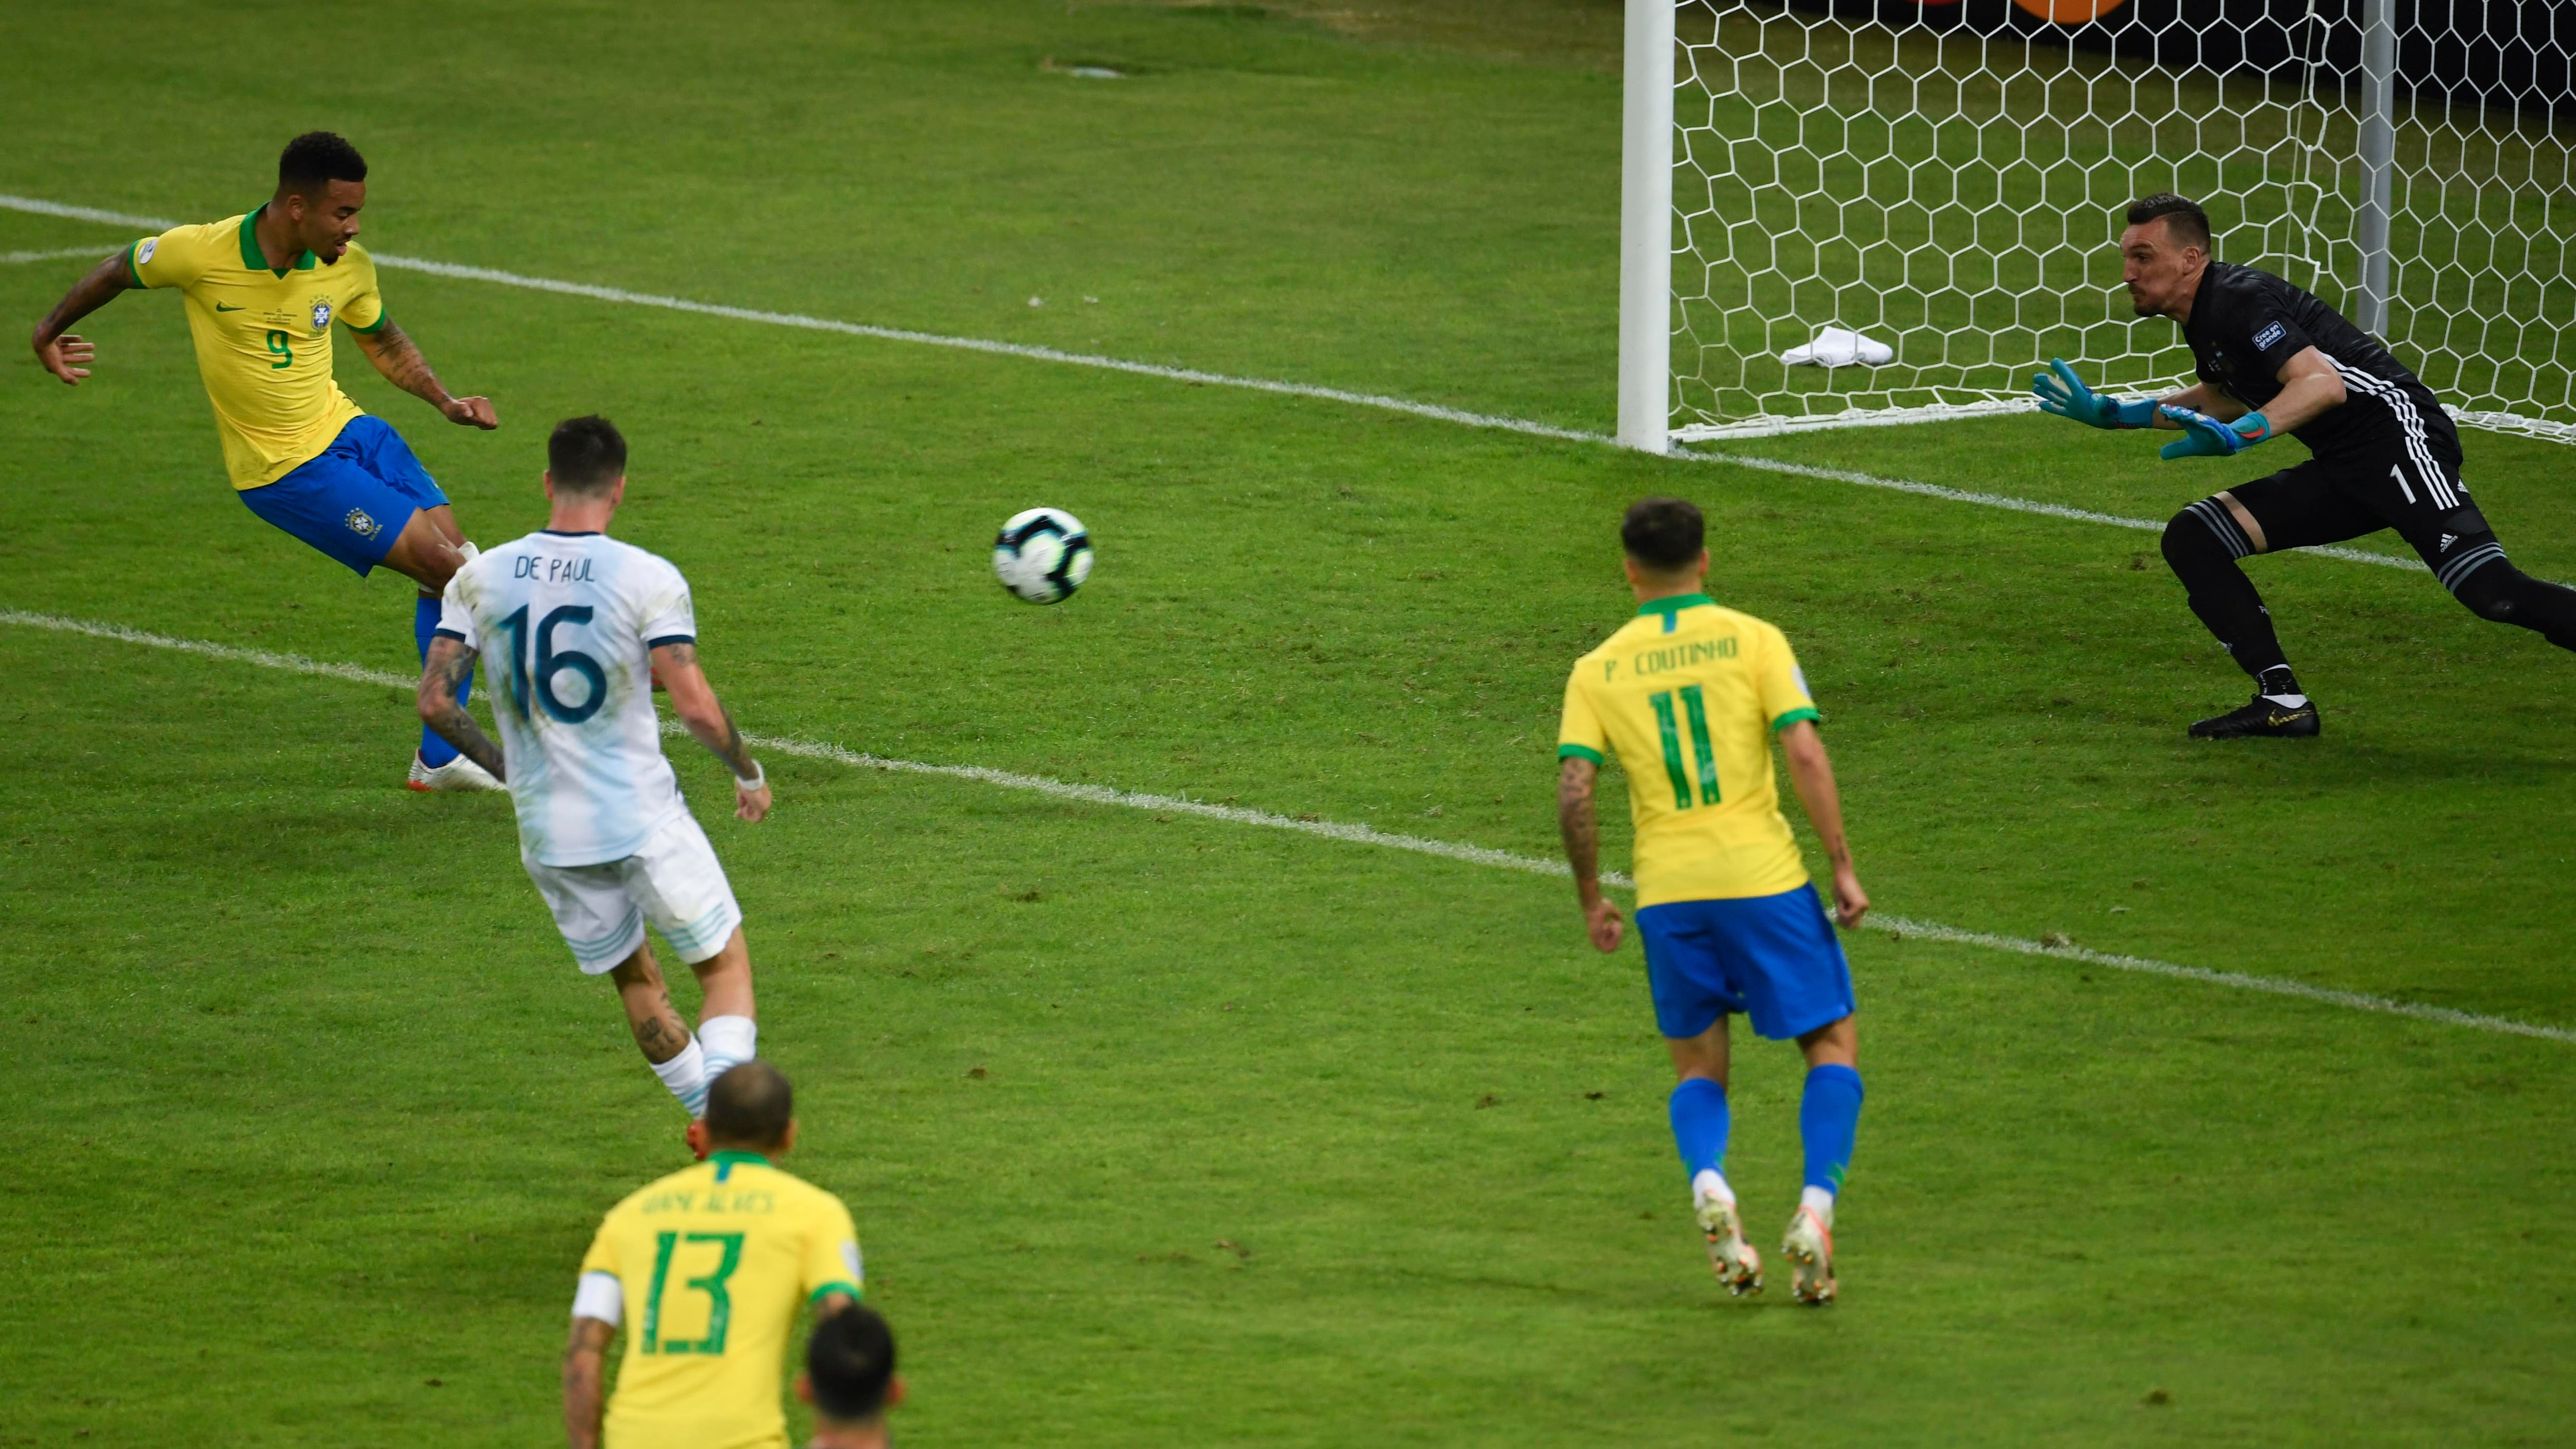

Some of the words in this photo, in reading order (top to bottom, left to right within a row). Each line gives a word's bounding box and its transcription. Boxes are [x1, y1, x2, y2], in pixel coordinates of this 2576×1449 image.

[267, 330, 292, 369] 9
[2255, 330, 2270, 343] Cree
[2259, 330, 2281, 348] grande
[2389, 464, 2416, 505] 1
[2440, 535, 2459, 553] adidas
[514, 556, 543, 580] DE
[549, 558, 595, 583] PAUL
[498, 603, 607, 724] 16
[1635, 637, 1739, 676] COUTINHO
[1649, 684, 1721, 811] 11
[640, 1231, 745, 1356] 13
